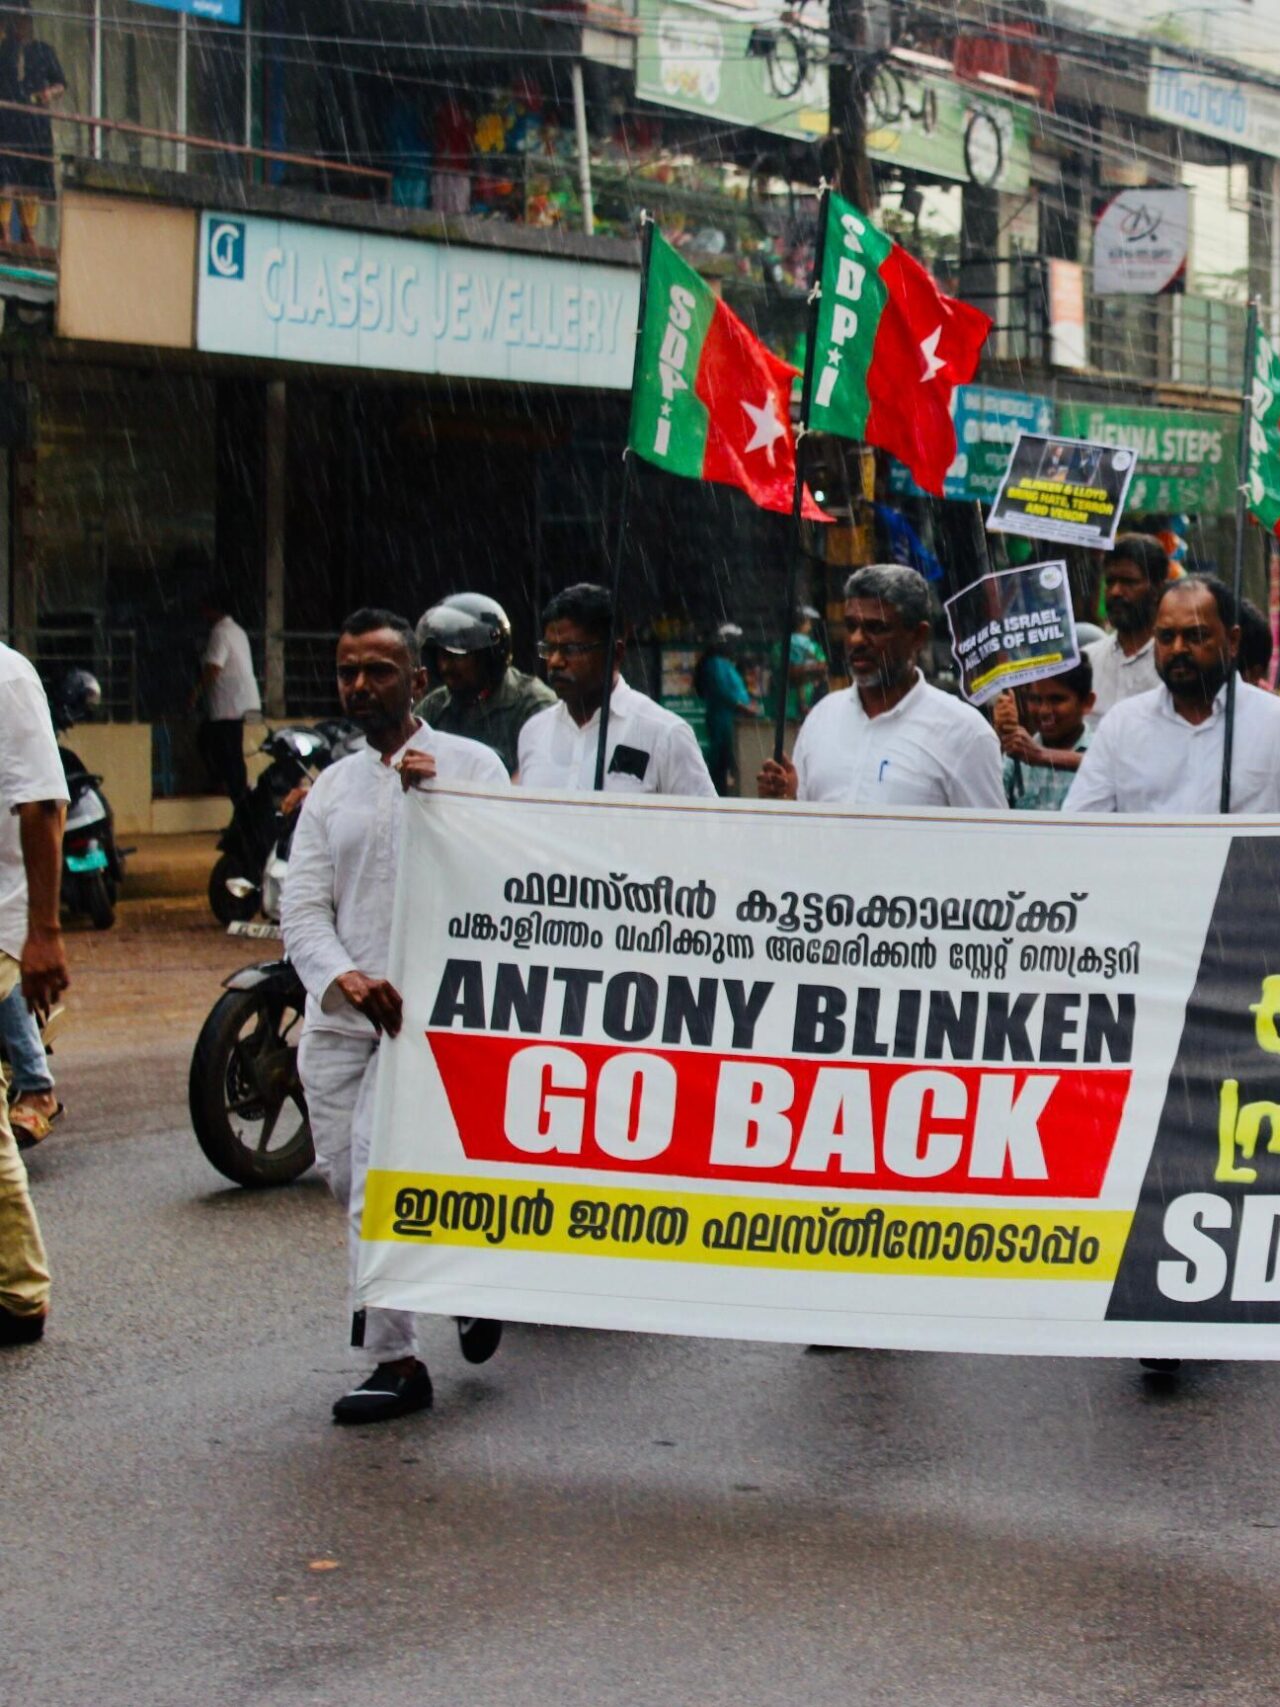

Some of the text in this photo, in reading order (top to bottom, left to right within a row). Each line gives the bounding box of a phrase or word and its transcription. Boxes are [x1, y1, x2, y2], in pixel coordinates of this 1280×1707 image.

[259, 247, 625, 356] CLASSIC JEWELLERY
[815, 213, 866, 408] SDPI
[653, 284, 697, 457] SDPI
[1089, 411, 1223, 464] HENNA STEPS
[989, 620, 1002, 635] &
[1003, 608, 1061, 632] ISRAEL
[1002, 632, 1025, 649] OF
[1027, 624, 1064, 644] EVIL
[503, 871, 1090, 933] ഫലസ്തീൻ കൂട്ടക്കൊലയ്ക്ക്
[448, 911, 602, 950] പങ്കാളിത്തം
[615, 920, 754, 964] വഹിക്കുന്ന
[766, 933, 937, 970] അമേരിക്കൻ
[1019, 941, 1141, 980] സെക്രട്ടറി
[428, 958, 1136, 1063] ANTONY BLINKEN
[503, 1046, 1061, 1180] GO BACK
[393, 1187, 1100, 1264] ഇന്ത്യൻ ജനത ഫലസ്തീനോടൊപ്പം
